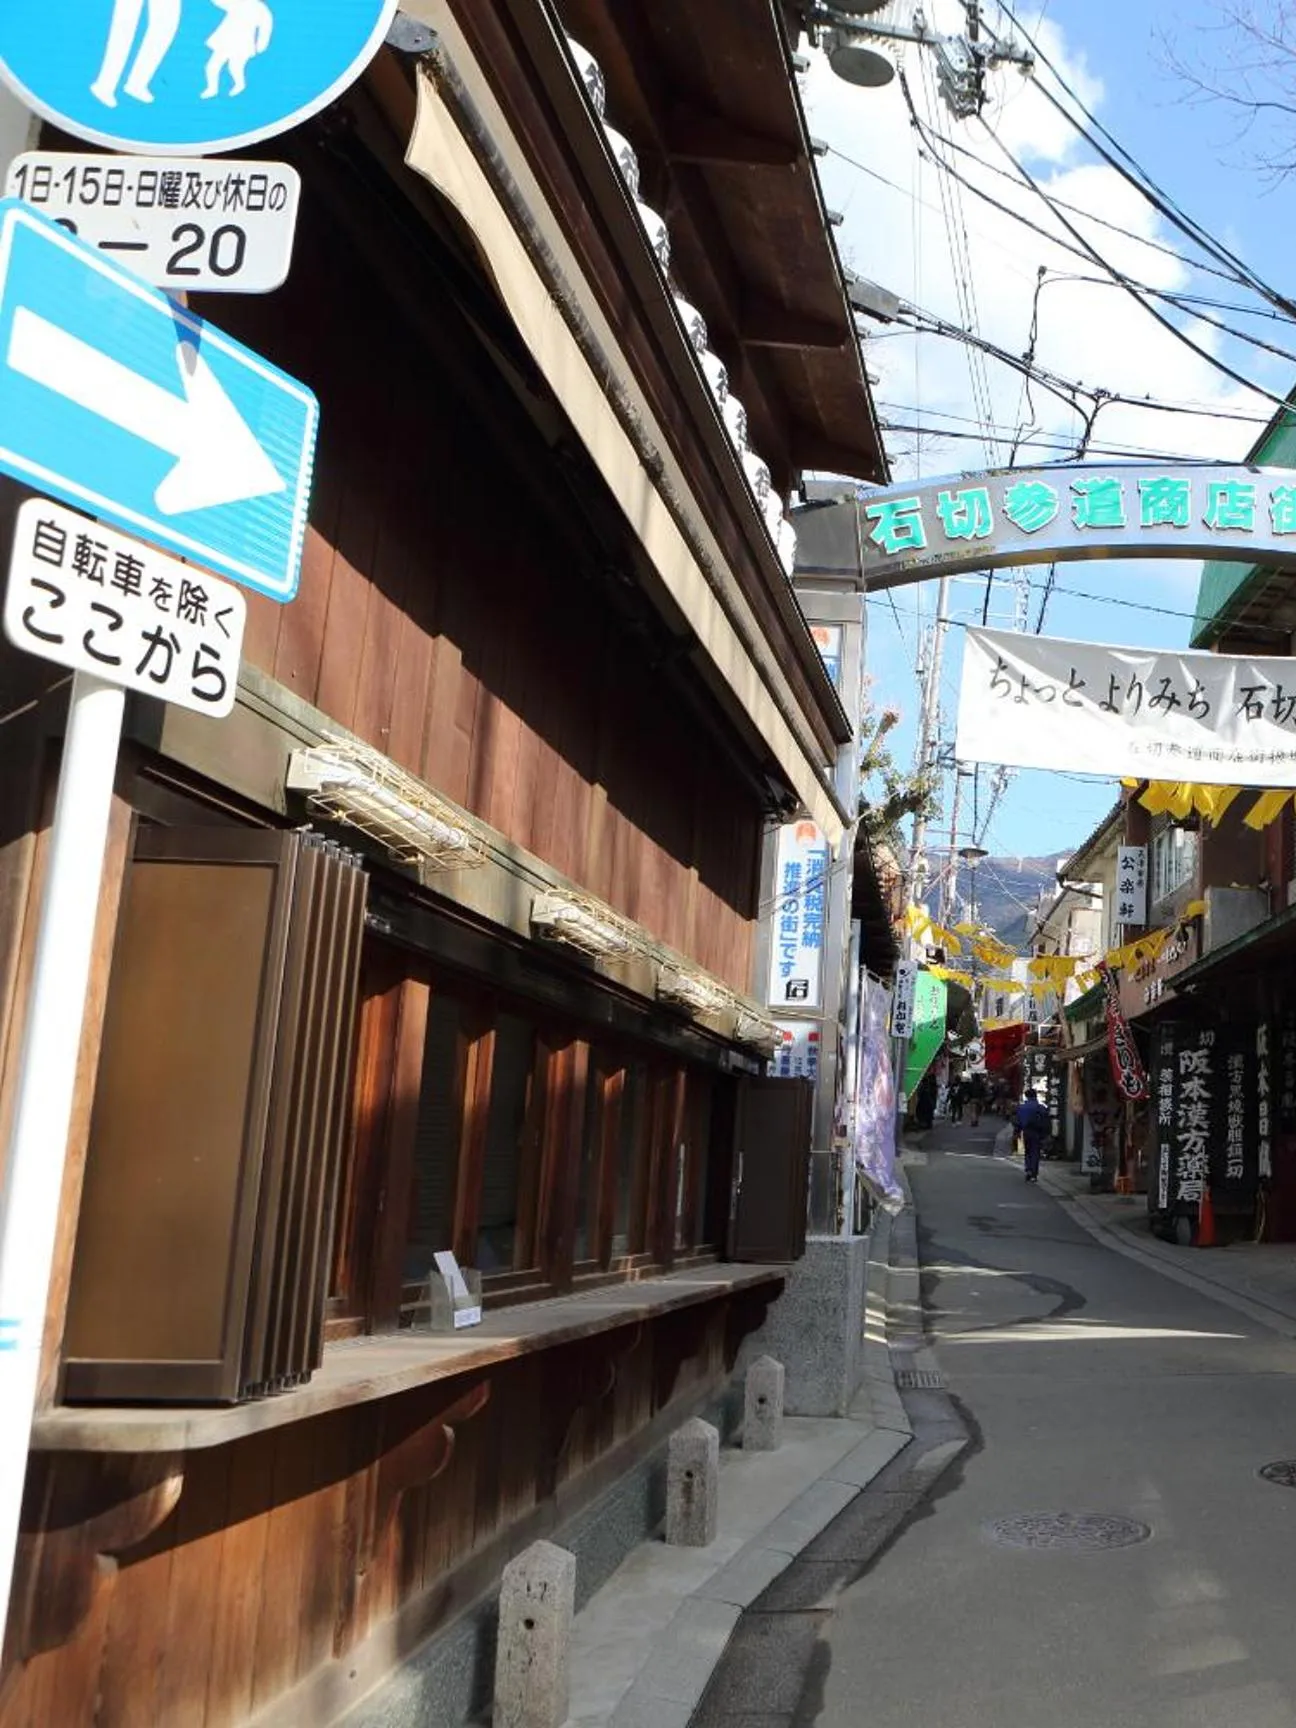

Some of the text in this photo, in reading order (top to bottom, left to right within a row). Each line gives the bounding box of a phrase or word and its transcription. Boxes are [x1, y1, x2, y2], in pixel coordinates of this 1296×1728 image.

[22, 577, 229, 702] ここから
[32, 518, 235, 640] 自転車を除く
[989, 656, 1086, 708] ちょっと
[1100, 673, 1211, 720] よりみち
